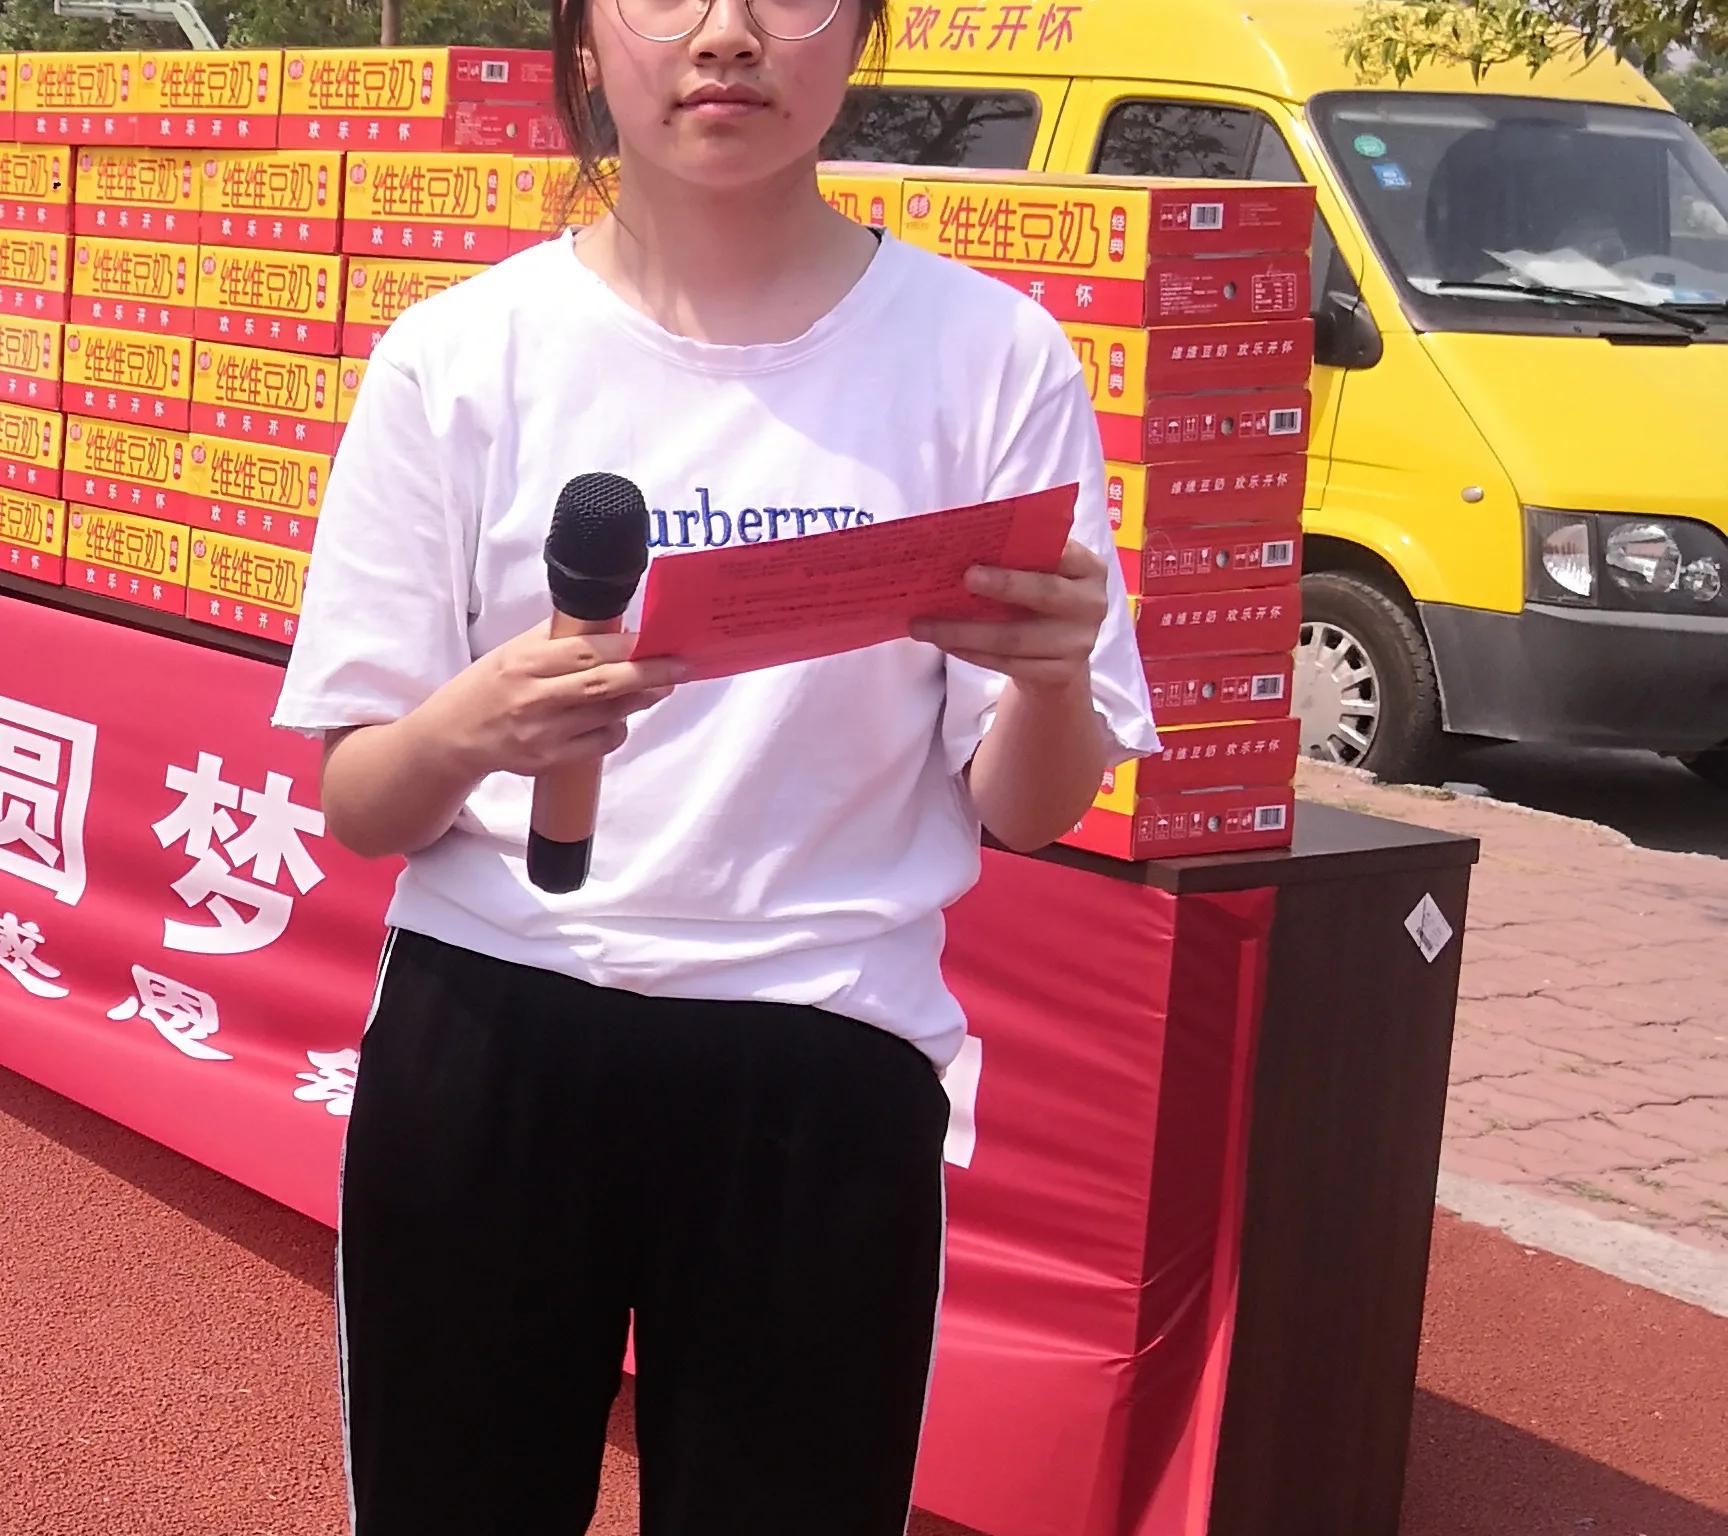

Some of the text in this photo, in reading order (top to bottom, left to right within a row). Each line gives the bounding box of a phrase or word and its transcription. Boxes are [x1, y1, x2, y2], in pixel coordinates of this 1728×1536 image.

[895, 2, 1083, 51] 欢乐开怀
[36, 63, 117, 108] 维维豆奶
[160, 61, 253, 108] 维维豆奶
[308, 59, 416, 110] 维维豆奶
[308, 120, 411, 141] 欢乐开怀
[96, 156, 178, 203] 维维豆奶
[221, 160, 313, 212] 维维豆奶
[372, 165, 480, 218] 维维豆奶
[372, 226, 475, 250] 欢乐开怀
[937, 195, 1100, 268] 维维豆奶
[1109, 214, 1126, 254] 经典
[92, 249, 172, 299] 维维豆奶
[219, 258, 311, 313] 维维豆奶
[371, 270, 471, 320] 维维
[219, 315, 308, 342] 欢乐开怀
[85, 337, 167, 390] 维维豆奶
[216, 353, 310, 412] 维维豆奶
[1109, 350, 1125, 390] 经典
[216, 410, 306, 440] 欢乐开怀
[85, 427, 169, 483] 维维豆奶
[210, 449, 303, 509] 维维豆奶
[211, 505, 299, 537] 欢乐开怀
[1109, 483, 1122, 523] 经典
[86, 515, 165, 574] 维维豆奶
[210, 544, 297, 609] 维维豆奶
[210, 600, 294, 636] 欢乐开怀
